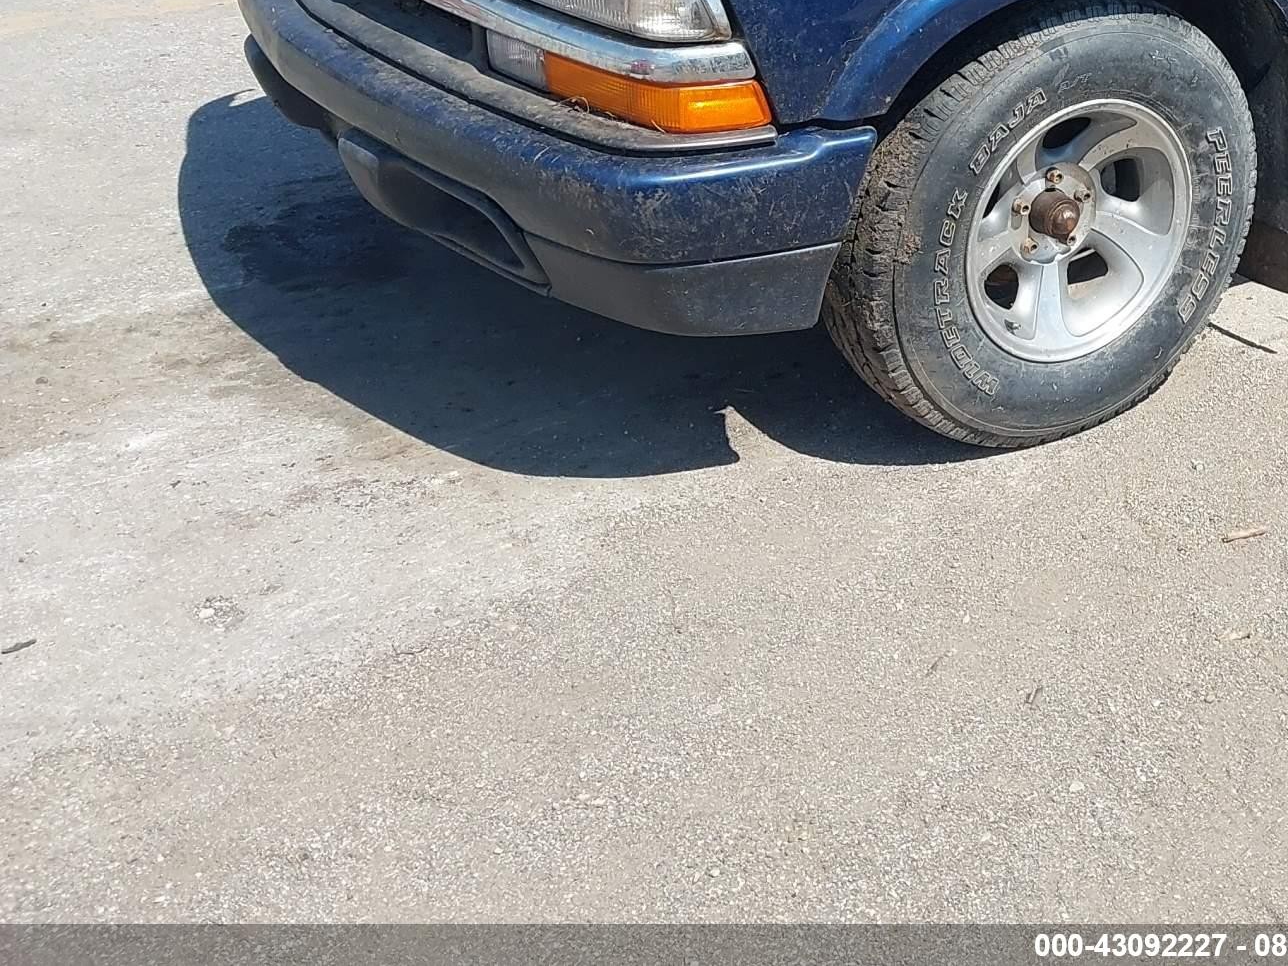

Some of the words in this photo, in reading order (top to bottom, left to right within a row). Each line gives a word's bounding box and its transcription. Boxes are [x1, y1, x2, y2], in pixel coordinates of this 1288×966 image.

[934, 186, 1000, 395] WIDETRACK
[969, 87, 1048, 175] BAJA
[1178, 126, 1234, 324] PEERLESS
